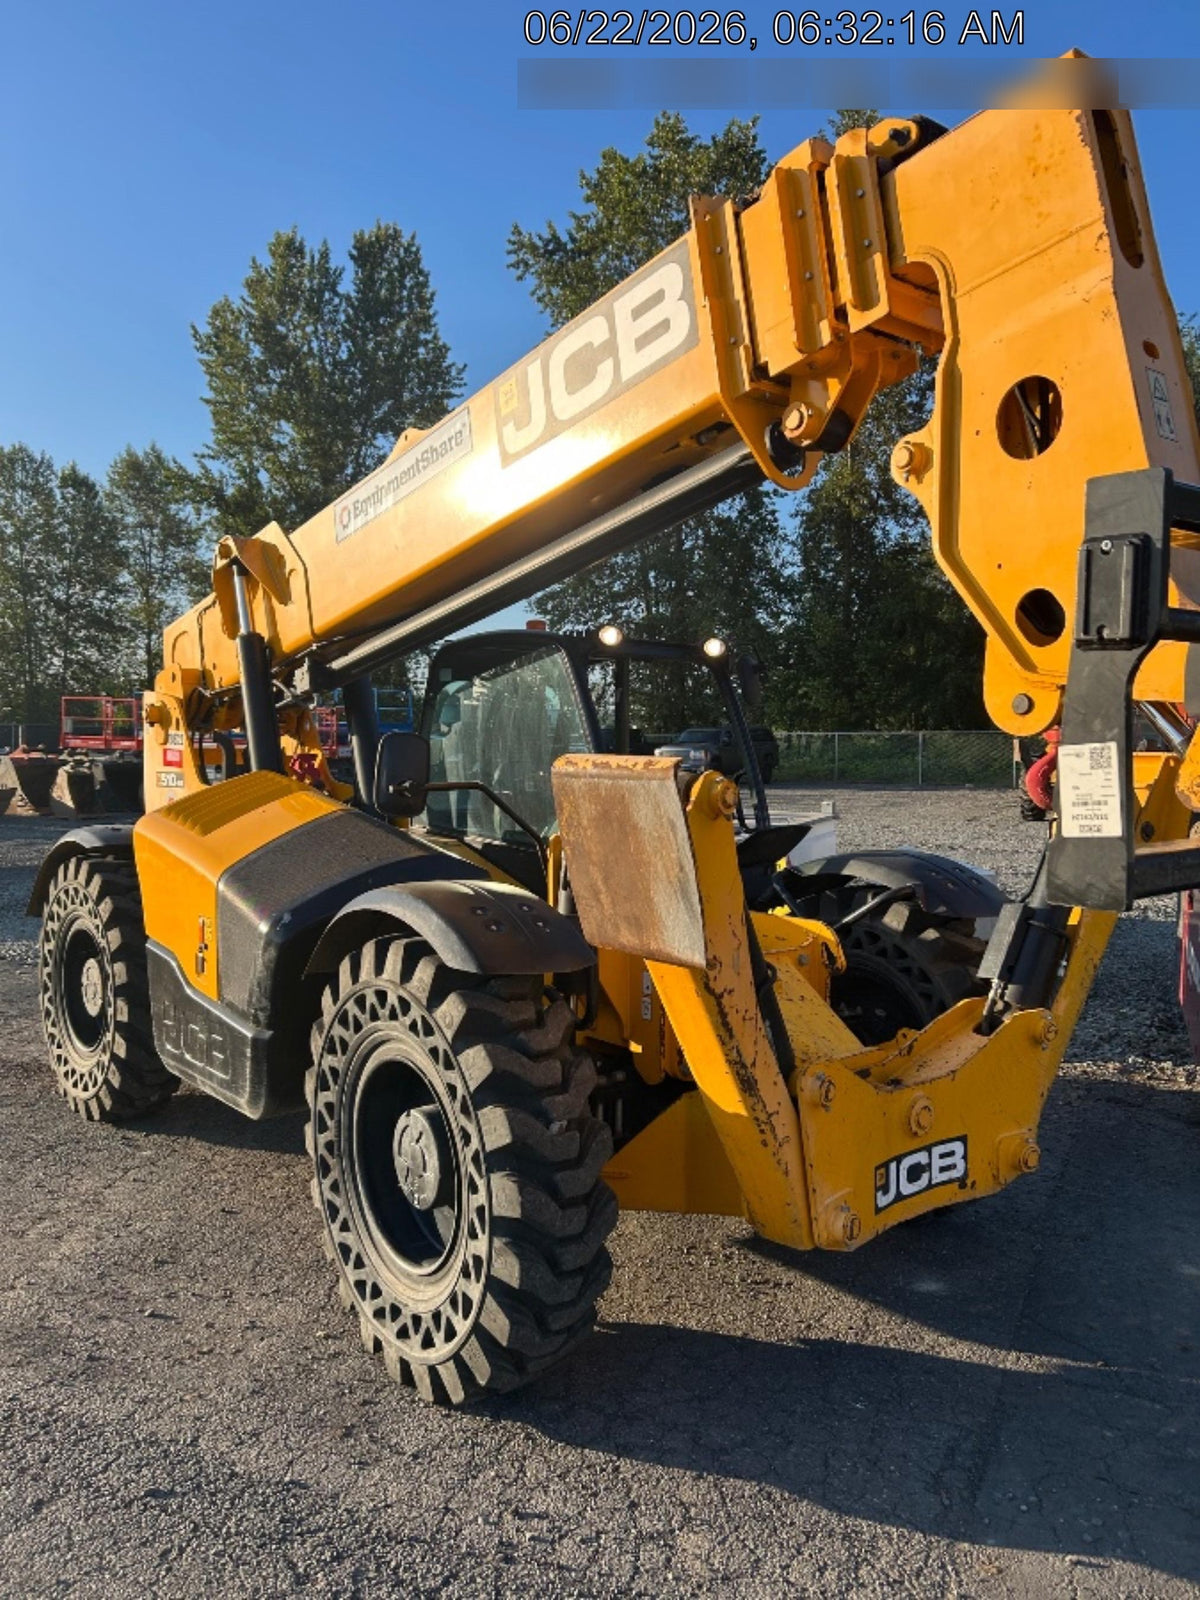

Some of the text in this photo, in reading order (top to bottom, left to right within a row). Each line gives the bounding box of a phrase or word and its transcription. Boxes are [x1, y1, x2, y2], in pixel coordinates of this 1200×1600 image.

[501, 262, 691, 454] JCB
[161, 1000, 232, 1080] JCB
[875, 1140, 967, 1208] JCB
